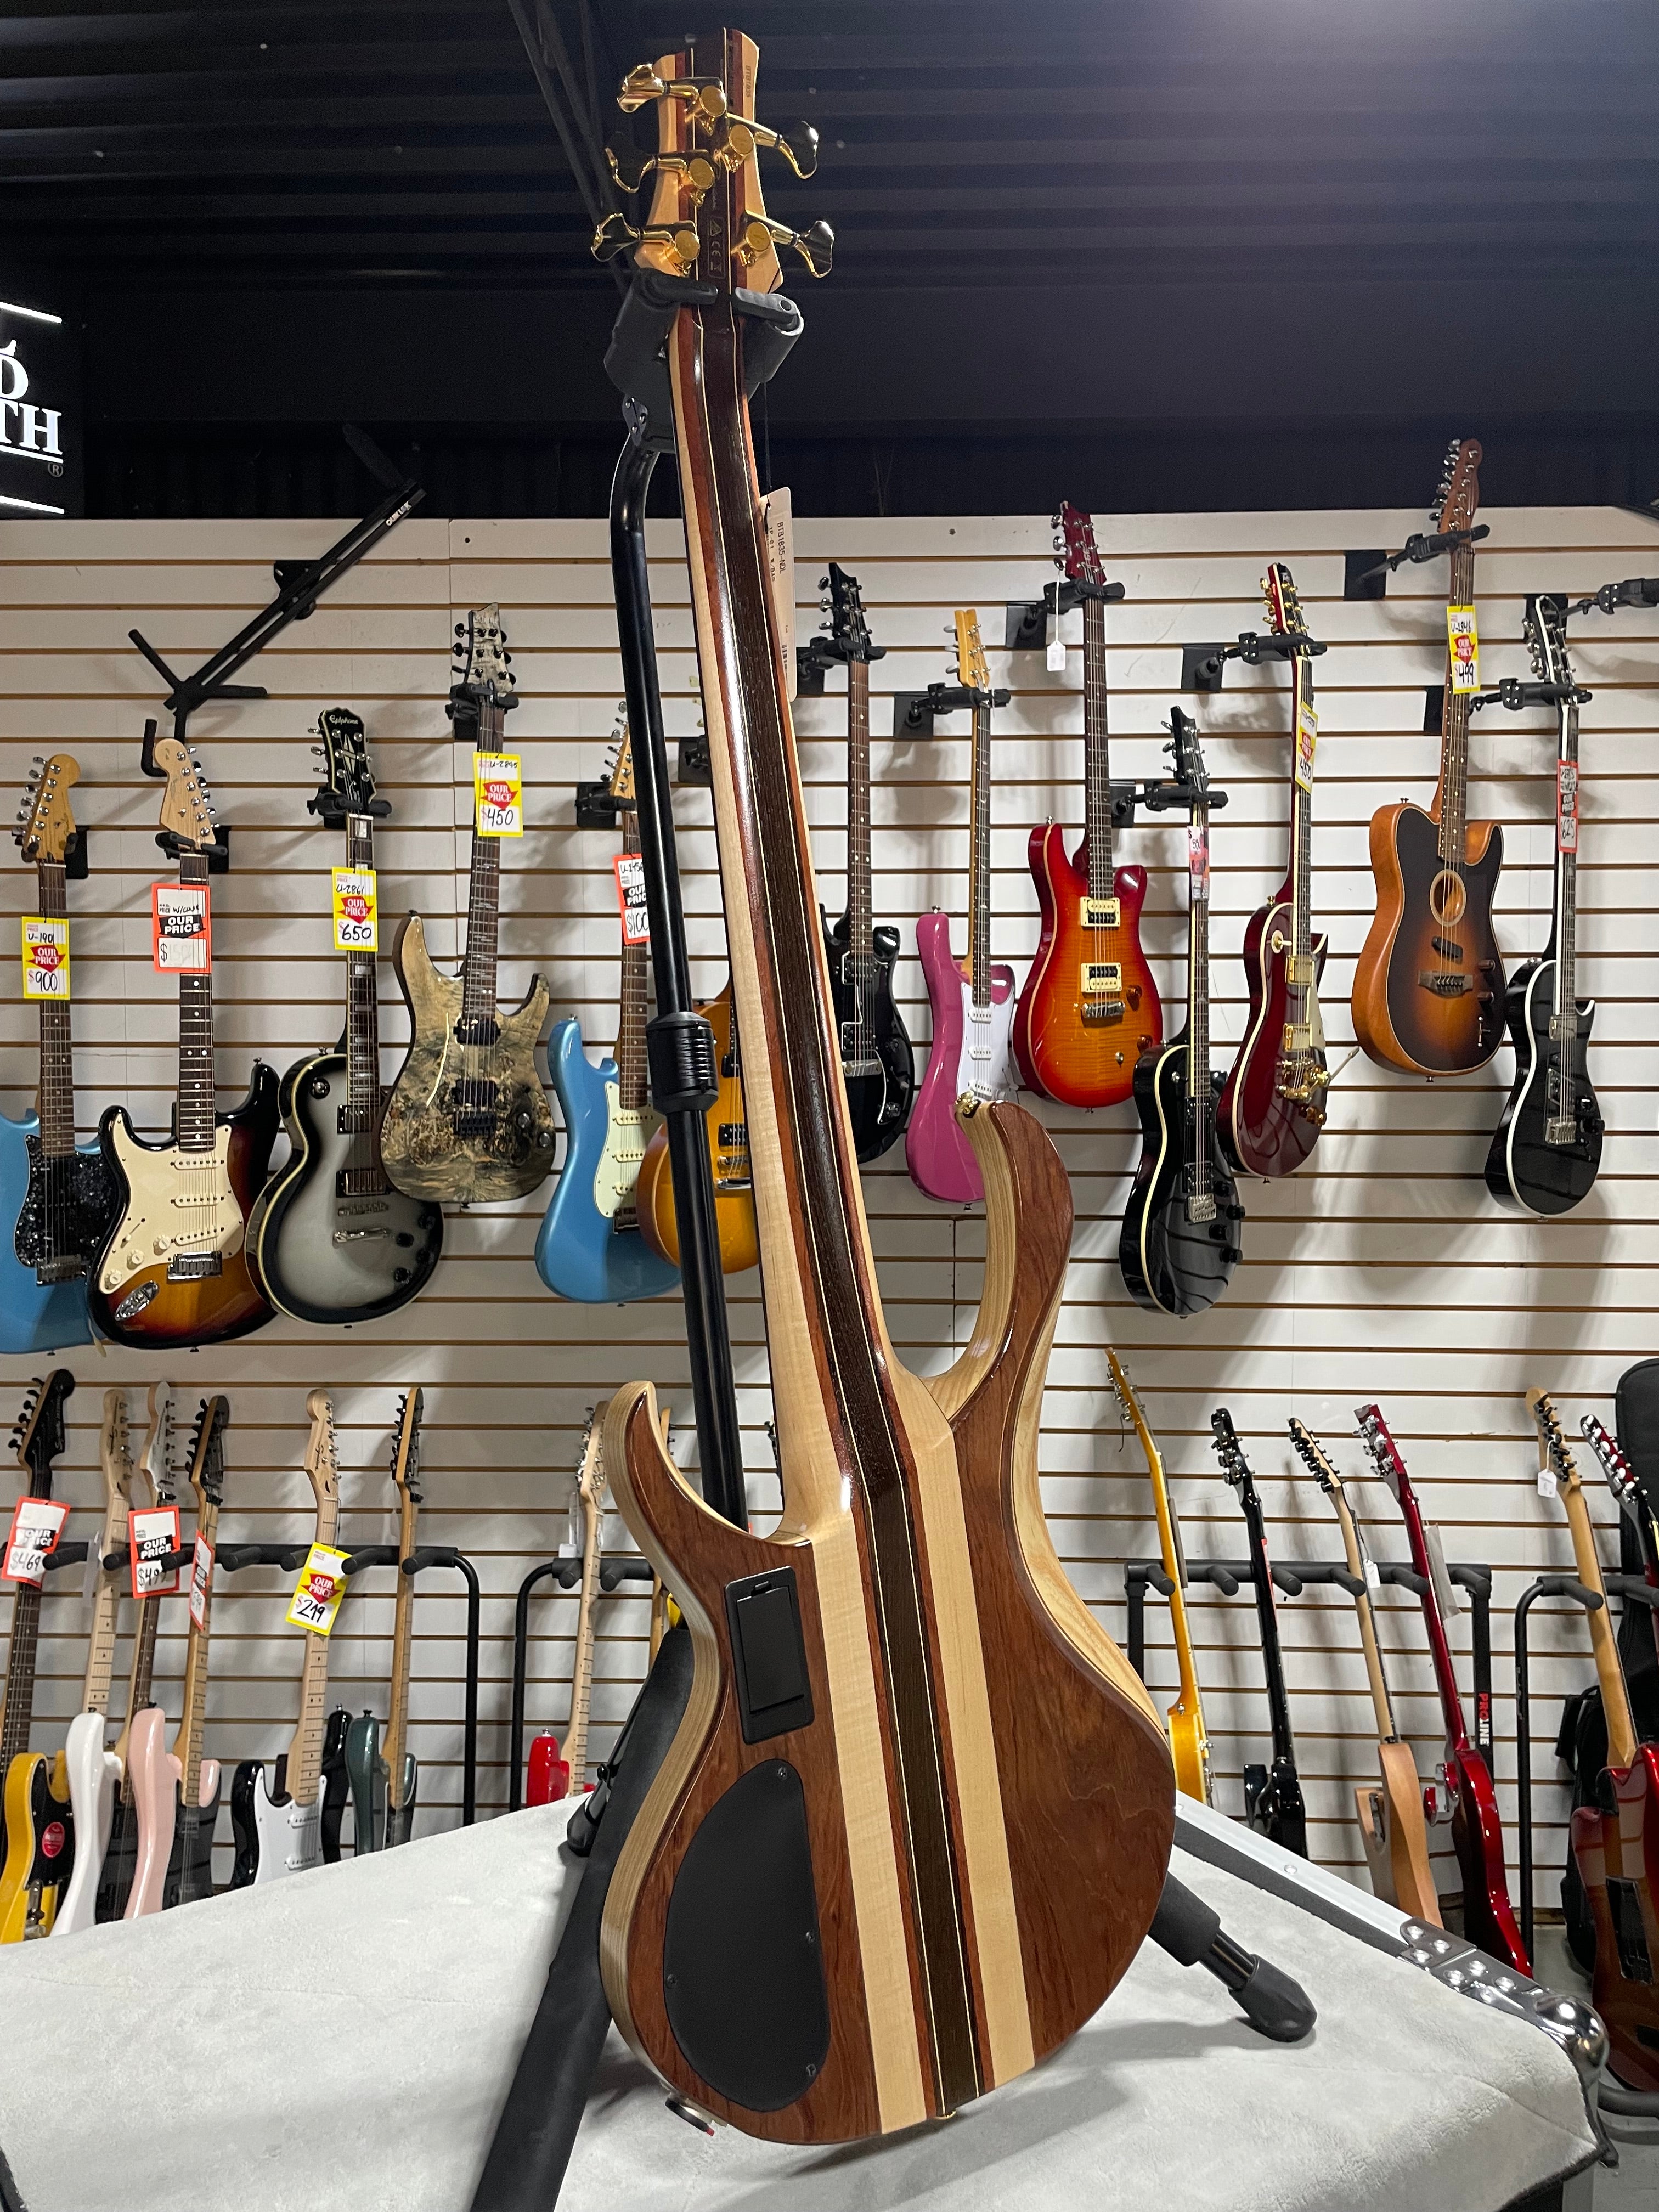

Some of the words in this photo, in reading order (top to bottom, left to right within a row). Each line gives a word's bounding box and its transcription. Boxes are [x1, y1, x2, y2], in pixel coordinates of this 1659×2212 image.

[777, 521, 786, 574] BTB1835-NDL
[329, 715, 359, 725] Epiphone
[489, 784, 509, 793] OUR
[488, 793, 512, 802] PRICE
[336, 884, 364, 895] U-2861
[347, 898, 365, 909] OUR
[627, 892, 646, 906] PRIC
[345, 907, 368, 917] PRICE
[168, 916, 194, 926] OUR
[164, 923, 200, 934] PRICE
[37, 947, 57, 957] OUR
[35, 956, 59, 966] PRICE
[144, 1537, 167, 1550] OUR
[140, 1543, 172, 1560] PRICE
[10, 1551, 41, 1572] $469
[314, 1576, 334, 1590] OUR
[308, 1583, 334, 1598] PRICE
[1479, 1692, 1490, 1746] PROLINE
